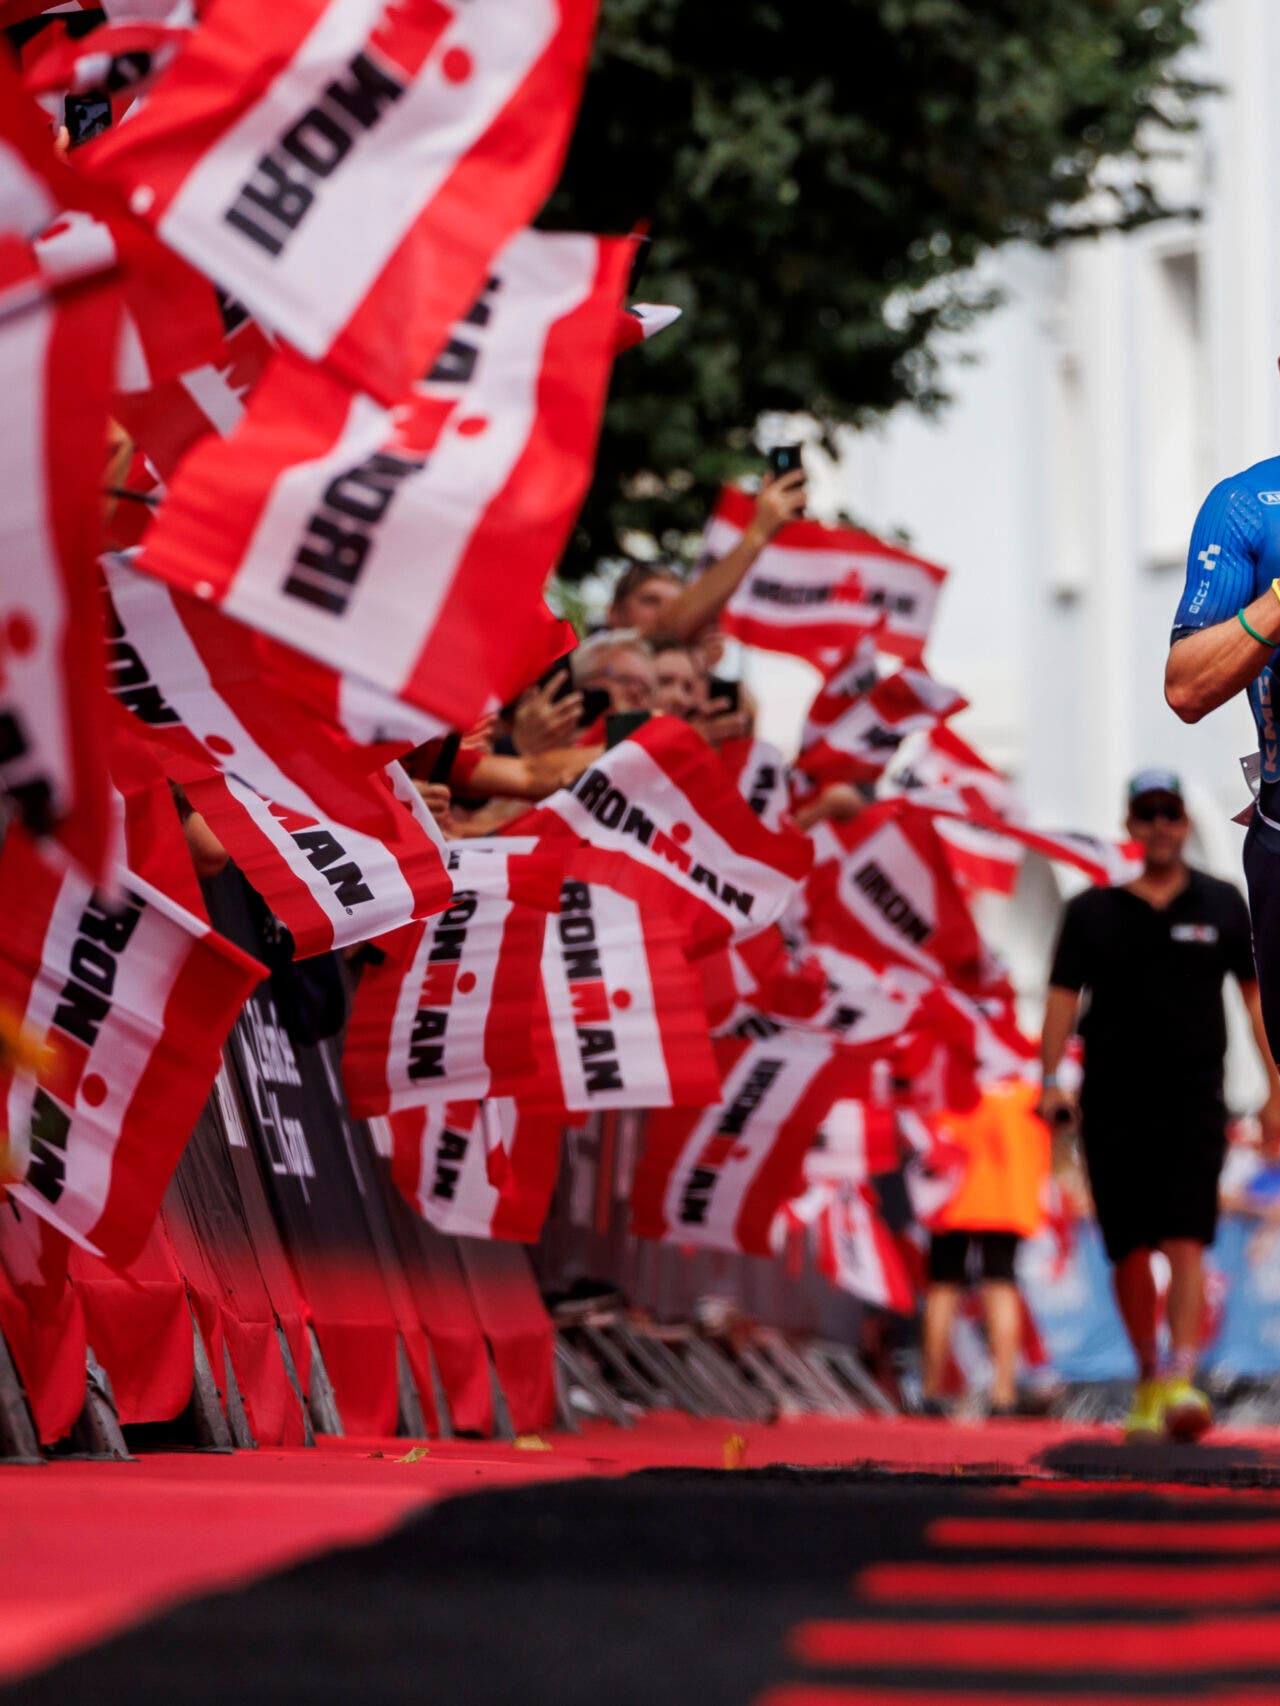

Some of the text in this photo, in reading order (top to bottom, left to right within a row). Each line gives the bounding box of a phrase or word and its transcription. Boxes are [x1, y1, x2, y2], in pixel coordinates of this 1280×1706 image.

[1258, 675, 1278, 773] KMC
[576, 768, 755, 916] RONMAN
[560, 878, 624, 1096] RONMAN
